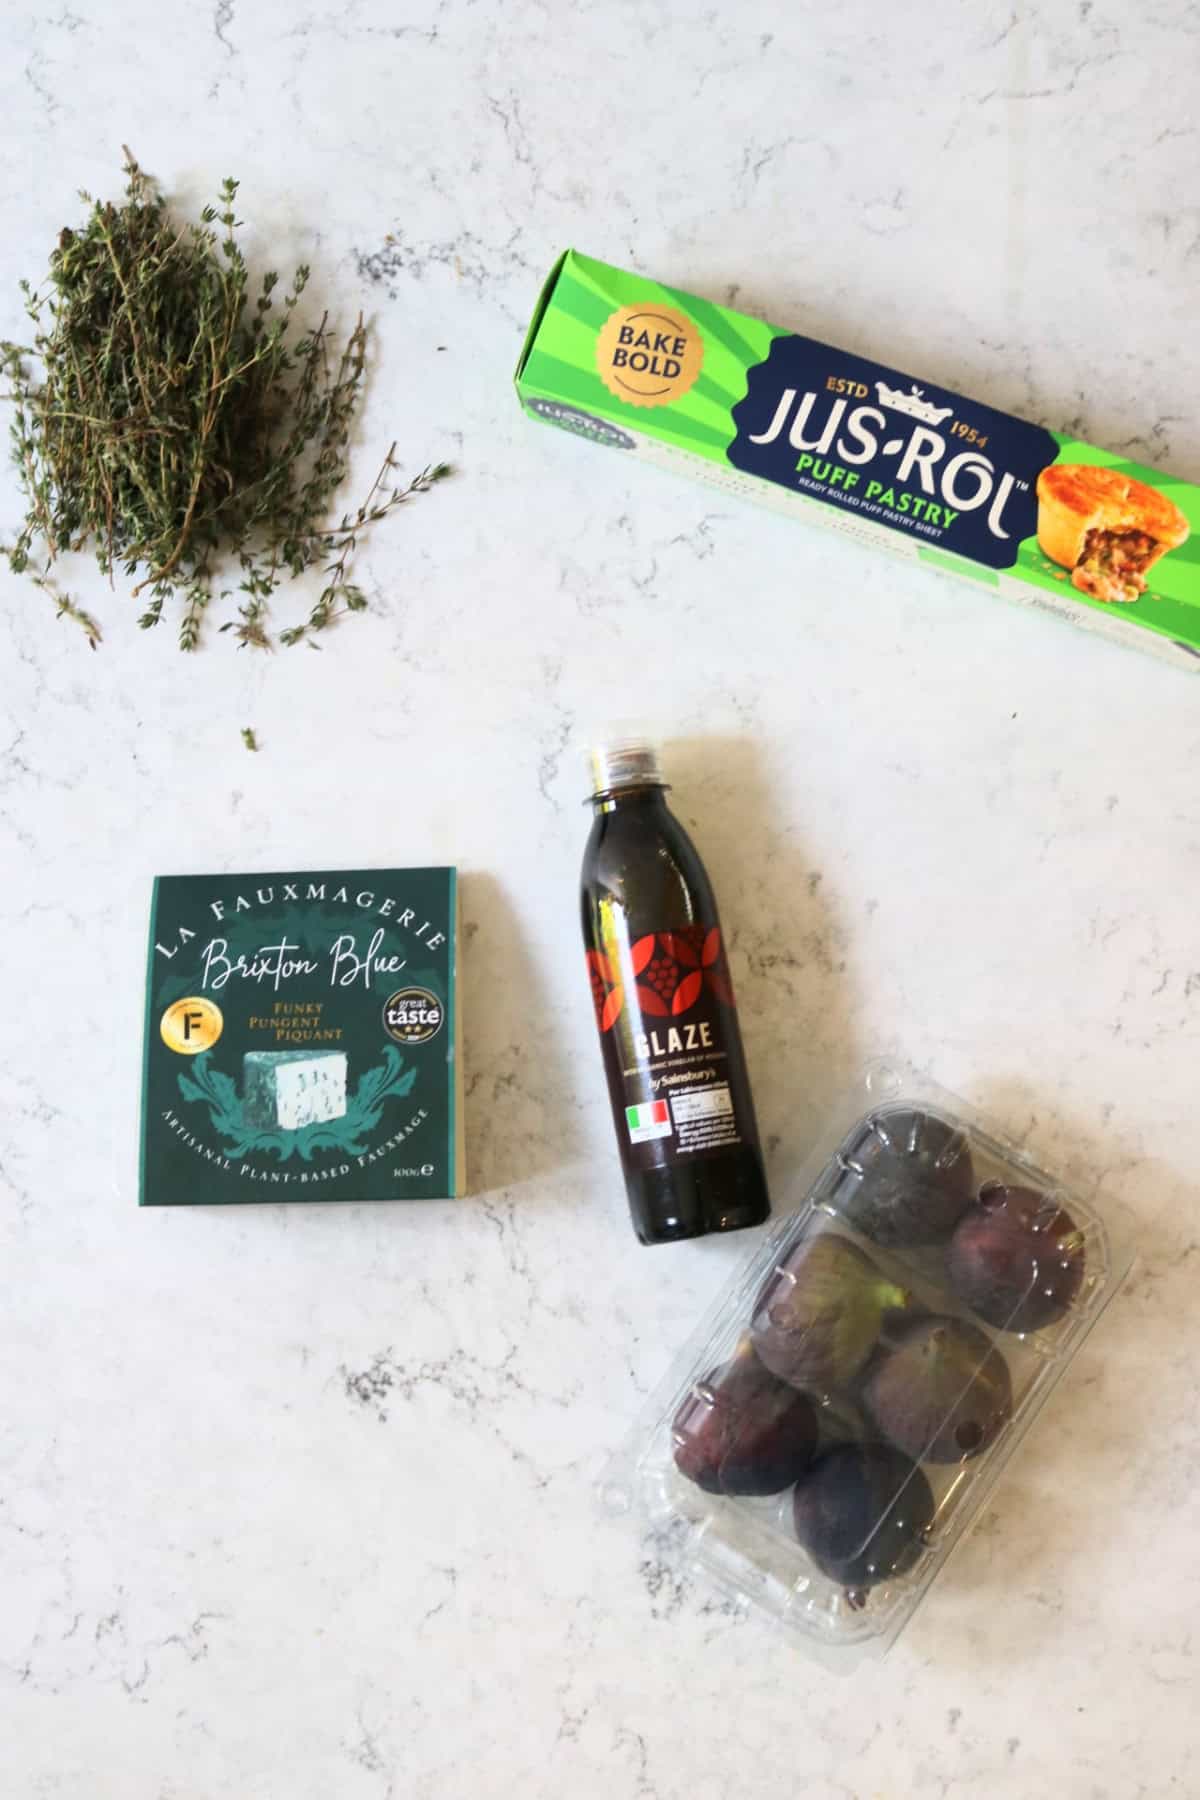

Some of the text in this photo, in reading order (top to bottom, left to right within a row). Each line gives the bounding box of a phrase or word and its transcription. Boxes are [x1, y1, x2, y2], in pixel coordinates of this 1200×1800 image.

[617, 325, 688, 358] BAKE
[612, 347, 682, 379] BOLD
[826, 376, 869, 399] ESTD
[949, 420, 990, 449] 1954
[795, 453, 861, 491] PUFF
[864, 480, 959, 530] PASTRY
[798, 477, 943, 537] READY ROLLED PUFF PASTRY SHEET
[155, 883, 446, 960] LA FAUXMAGERIE
[201, 927, 408, 992] Brixton Blue
[273, 1002, 324, 1015] FUNKY
[387, 1008, 440, 1025] taste
[399, 999, 427, 1011] great
[184, 1012, 203, 1041] F
[249, 1016, 320, 1029] PUNGENT
[275, 1028, 343, 1043] PIQUANT
[661, 1068, 717, 1088] Sainsbury's
[161, 1108, 429, 1183] ARTISANAL PLANT-BASED FAUXMAGE
